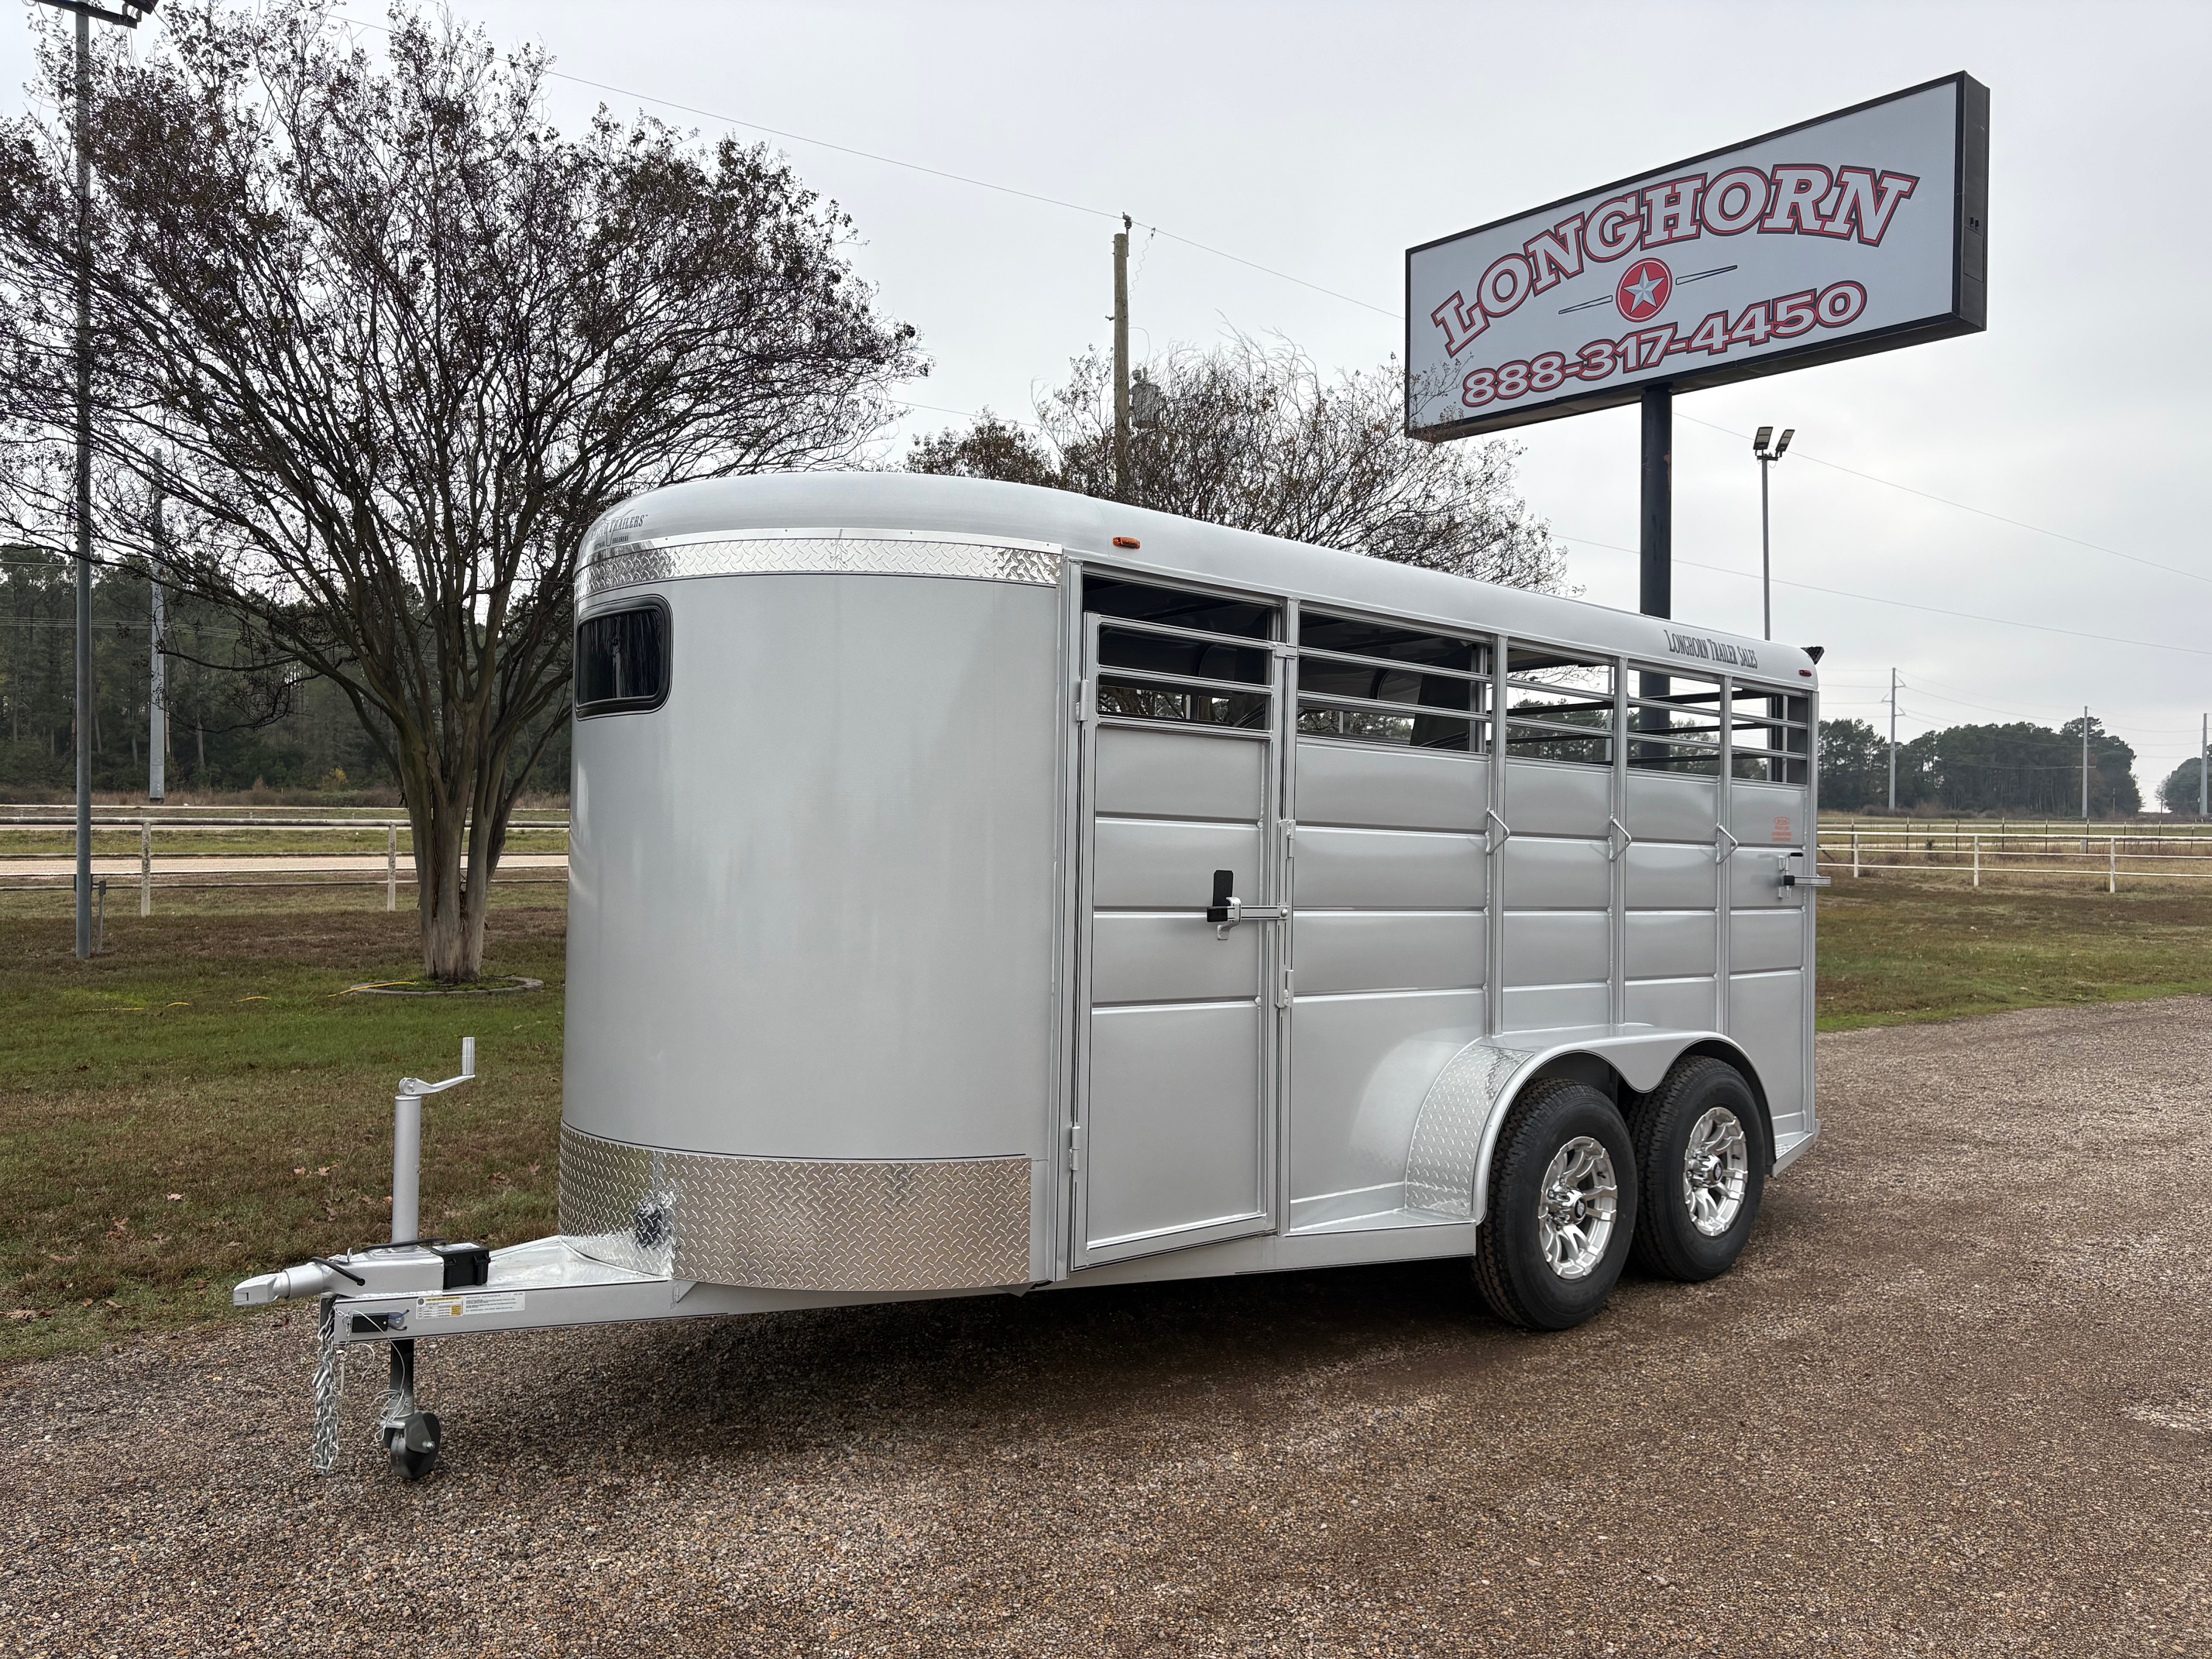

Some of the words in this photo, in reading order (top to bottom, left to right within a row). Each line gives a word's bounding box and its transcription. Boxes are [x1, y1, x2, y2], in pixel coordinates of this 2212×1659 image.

[1431, 163, 1920, 357] LONGHORN
[1462, 280, 1867, 407] 888-317-4450
[1664, 629, 1709, 659] LONGHORN
[1707, 639, 1738, 665] TRAILER
[1736, 645, 1758, 669] SALES
